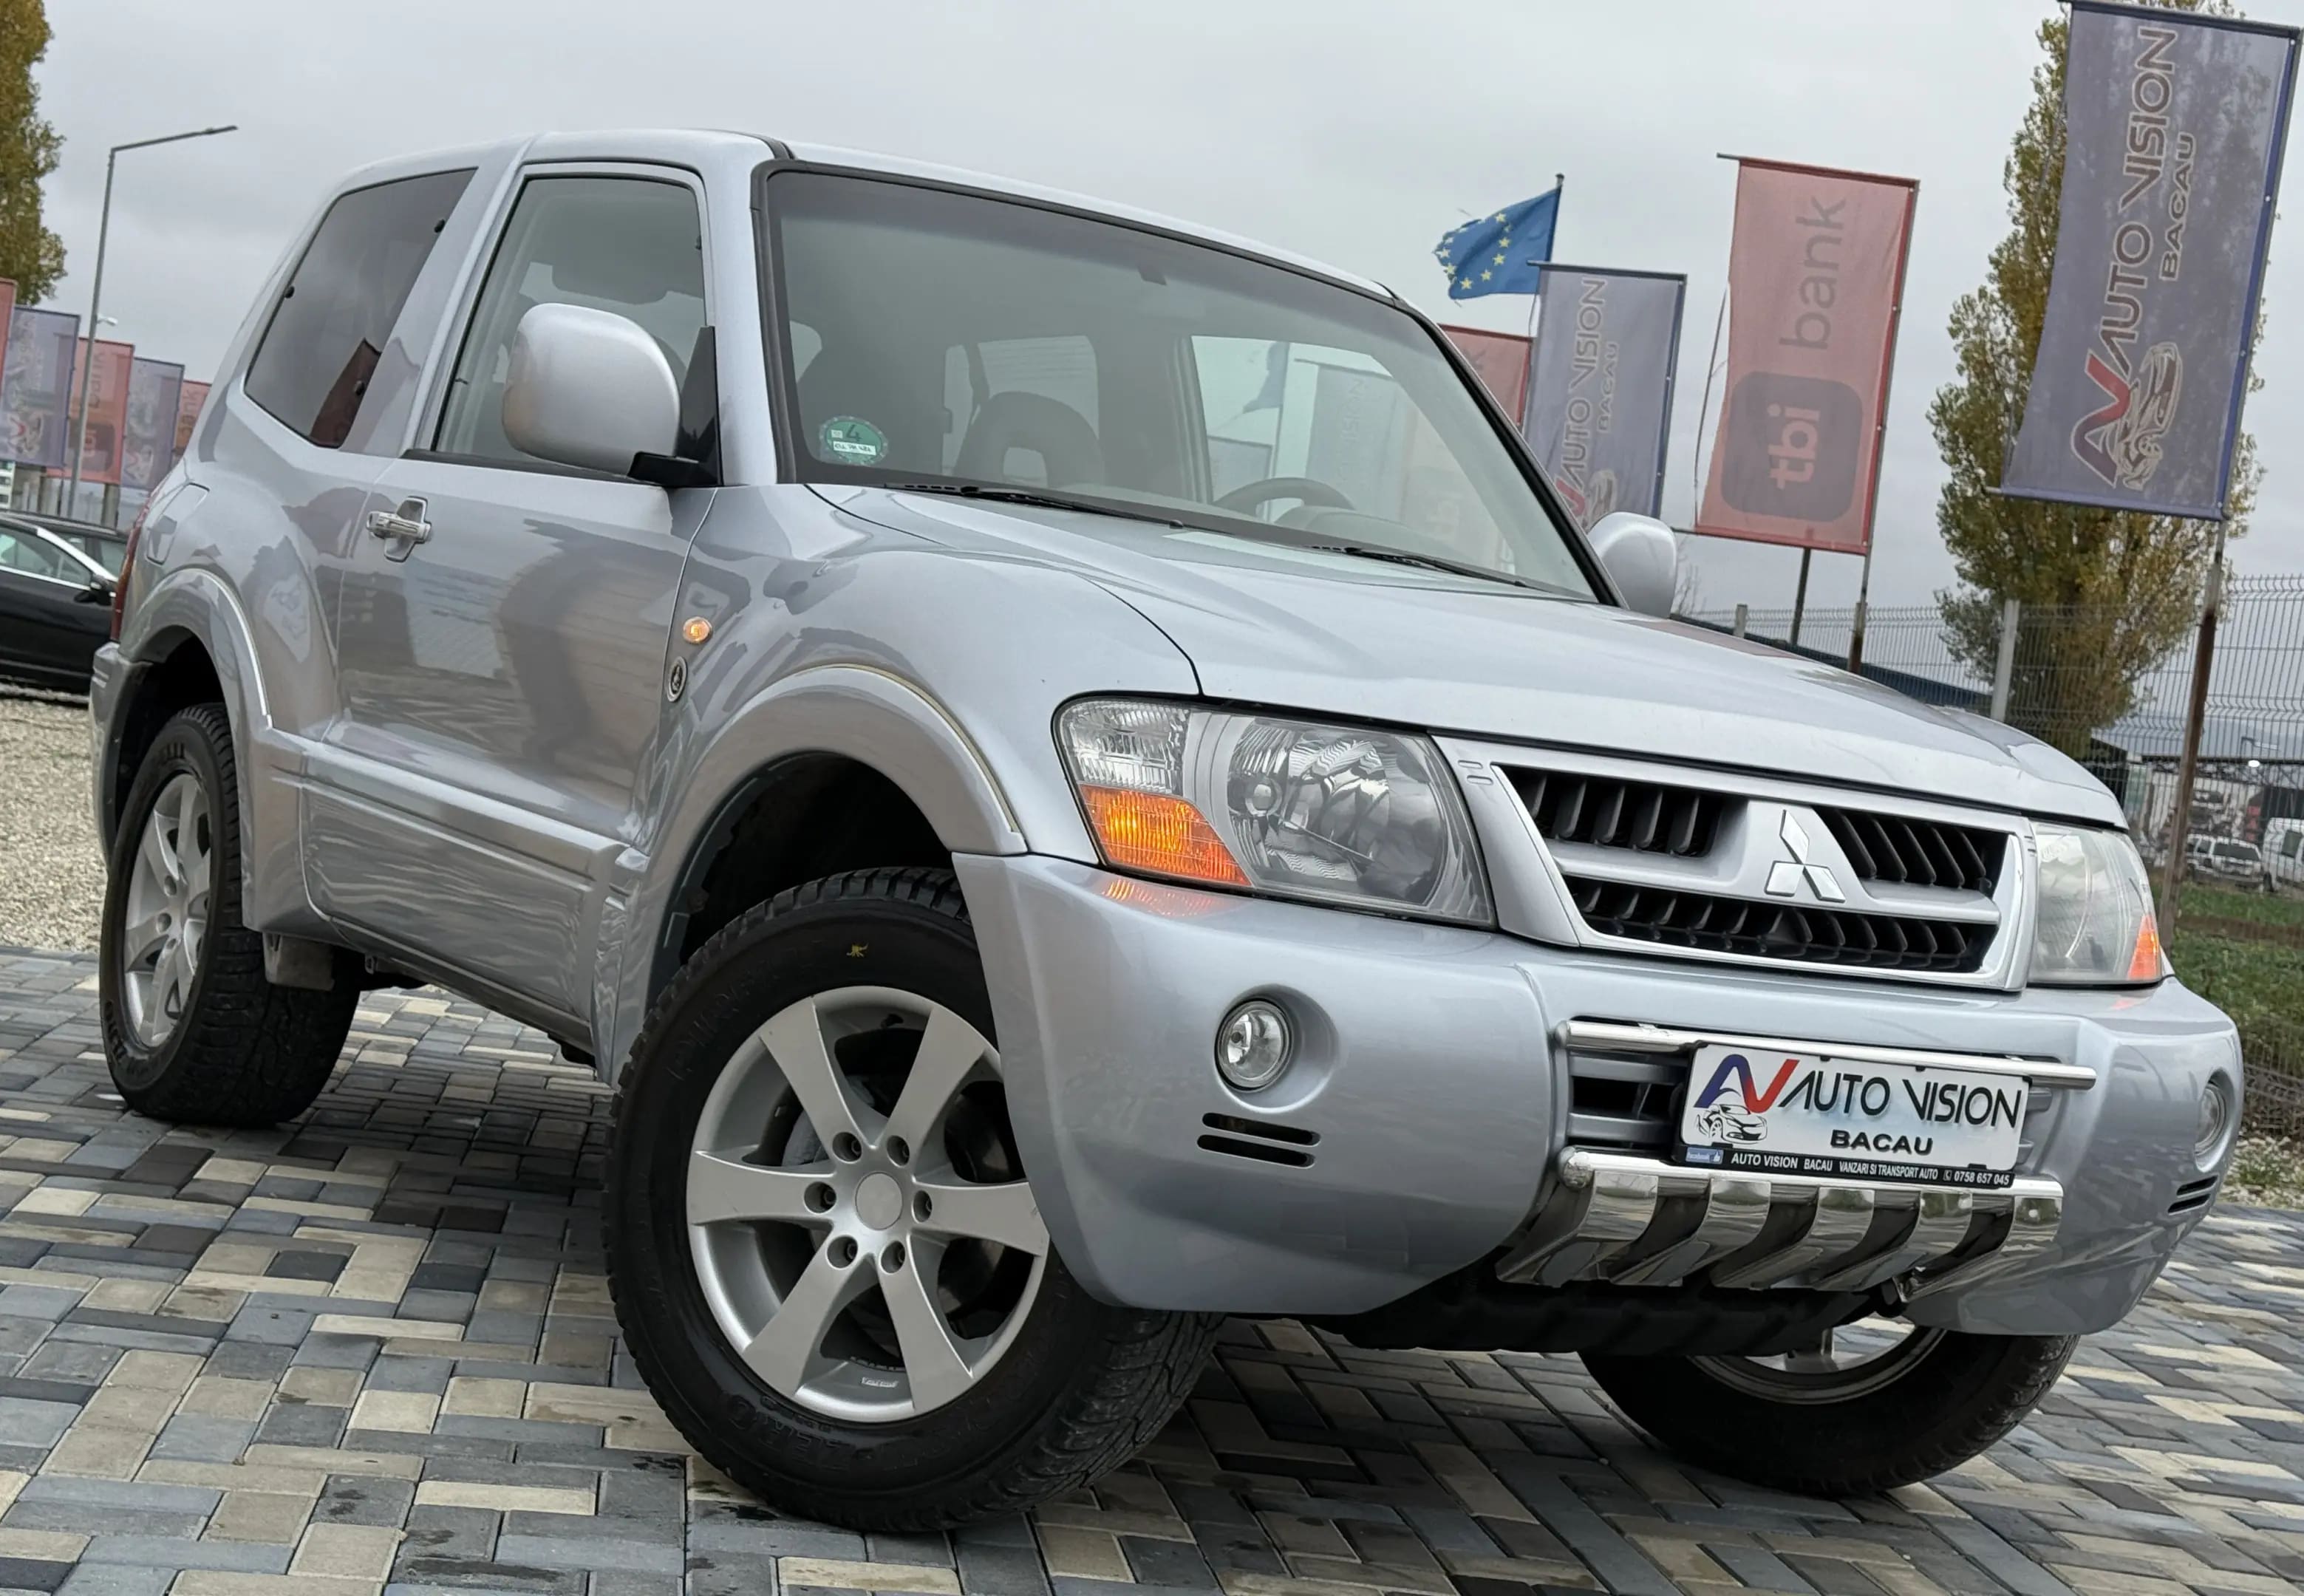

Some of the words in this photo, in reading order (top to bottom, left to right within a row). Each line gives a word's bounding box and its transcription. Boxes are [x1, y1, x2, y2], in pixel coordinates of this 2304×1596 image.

[2119, 27, 2178, 211] VISION
[2160, 133, 2195, 280] BACAU
[1779, 195, 1847, 351] bank
[2100, 222, 2153, 379] AUTO
[1569, 277, 1608, 389] VISION
[1598, 342, 1619, 434] BACAU
[1559, 398, 1592, 488] AUTO
[1766, 403, 1821, 490] tbi
[1778, 1068, 1891, 1116] AUTO
[1903, 1077, 2022, 1129] VISION
[1830, 1129, 1934, 1156] BACAU
[1731, 1153, 1762, 1166] AUTO
[1764, 1155, 1798, 1168] VISION
[1804, 1159, 1833, 1172] BACAU
[1839, 1161, 1869, 1174] VANZARI
[1870, 1164, 1877, 1175] SI
[1878, 1164, 1919, 1179] TRANSPORT
[1919, 1167, 1937, 1180] AUTO
[1954, 1170, 1975, 1183] 0758
[1977, 1173, 1993, 1184] 657
[1994, 1174, 2010, 1185] 045
